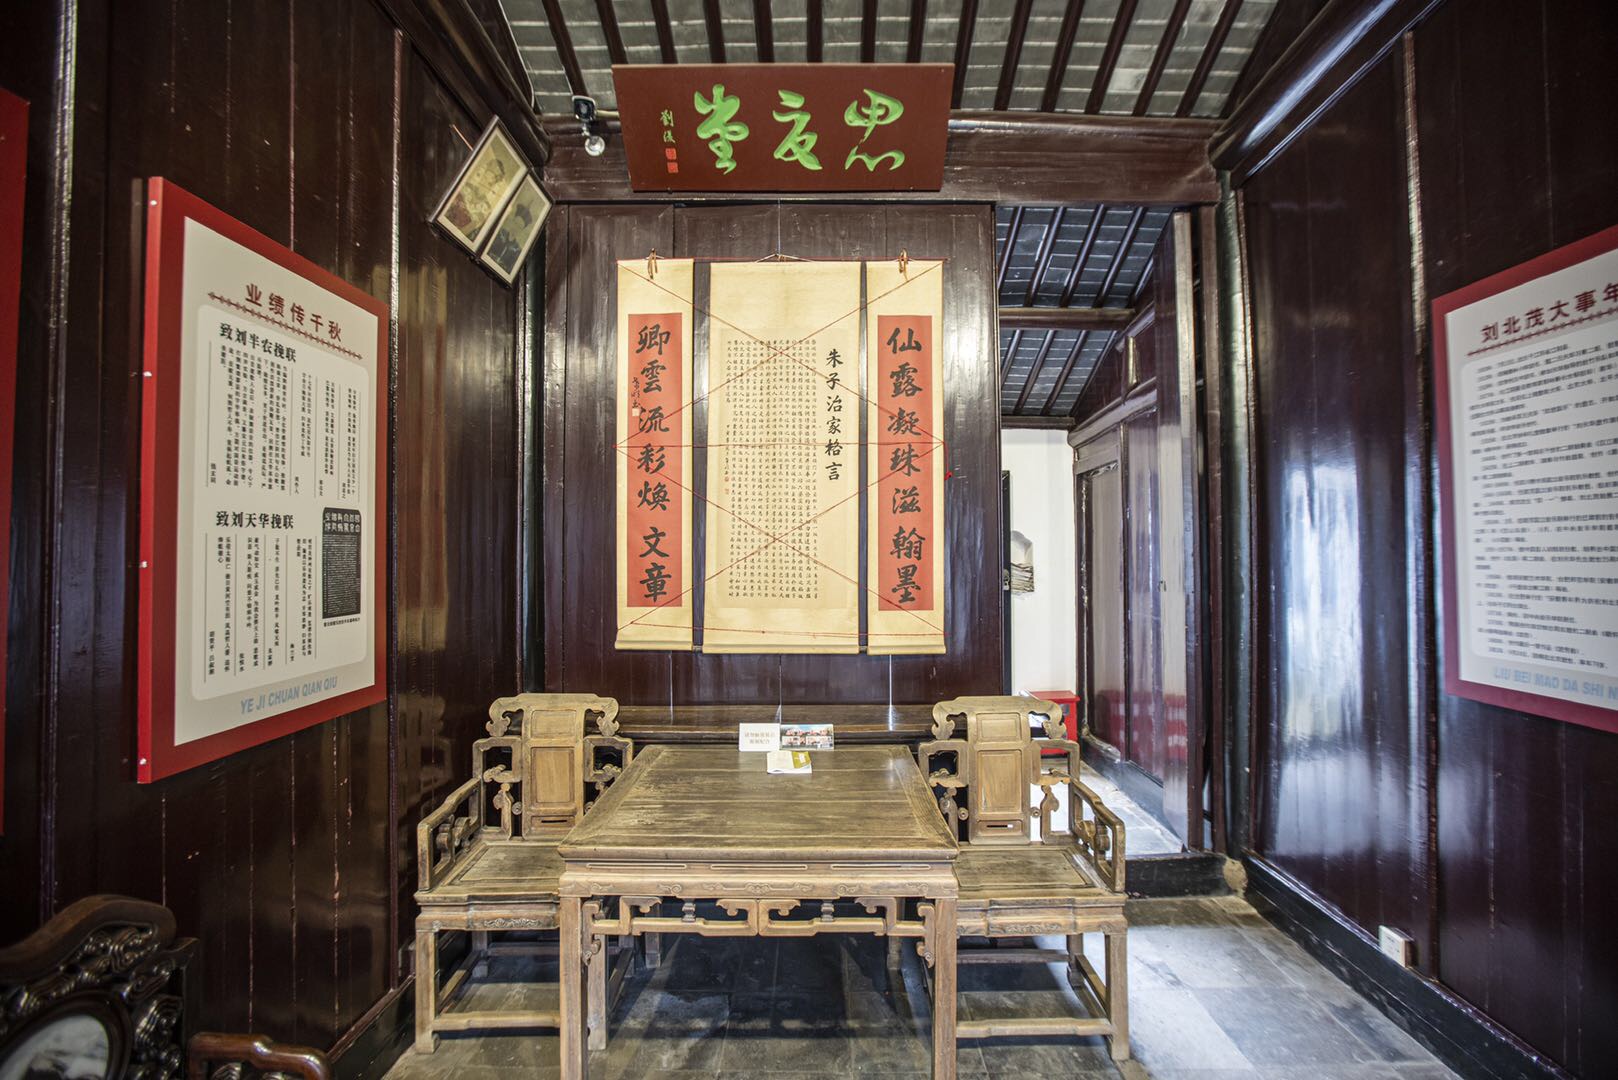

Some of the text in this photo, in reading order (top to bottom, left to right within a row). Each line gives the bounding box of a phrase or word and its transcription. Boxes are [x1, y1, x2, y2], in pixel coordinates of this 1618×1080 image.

[245, 283, 341, 342] 业绩传千秋
[1481, 283, 1618, 343] 刘北茂大事年
[220, 322, 296, 362] 致刘半农挽联
[825, 348, 844, 481] 朱子治家格言
[886, 327, 926, 604] 仙露凝珠滋翰墨
[216, 510, 294, 530] 致刘天华挽联
[240, 675, 338, 715] YE JI CHUAN QIAN QIU
[1514, 670, 1531, 684] BEI
[1563, 678, 1579, 692] DA
[1583, 681, 1604, 697] SHI
